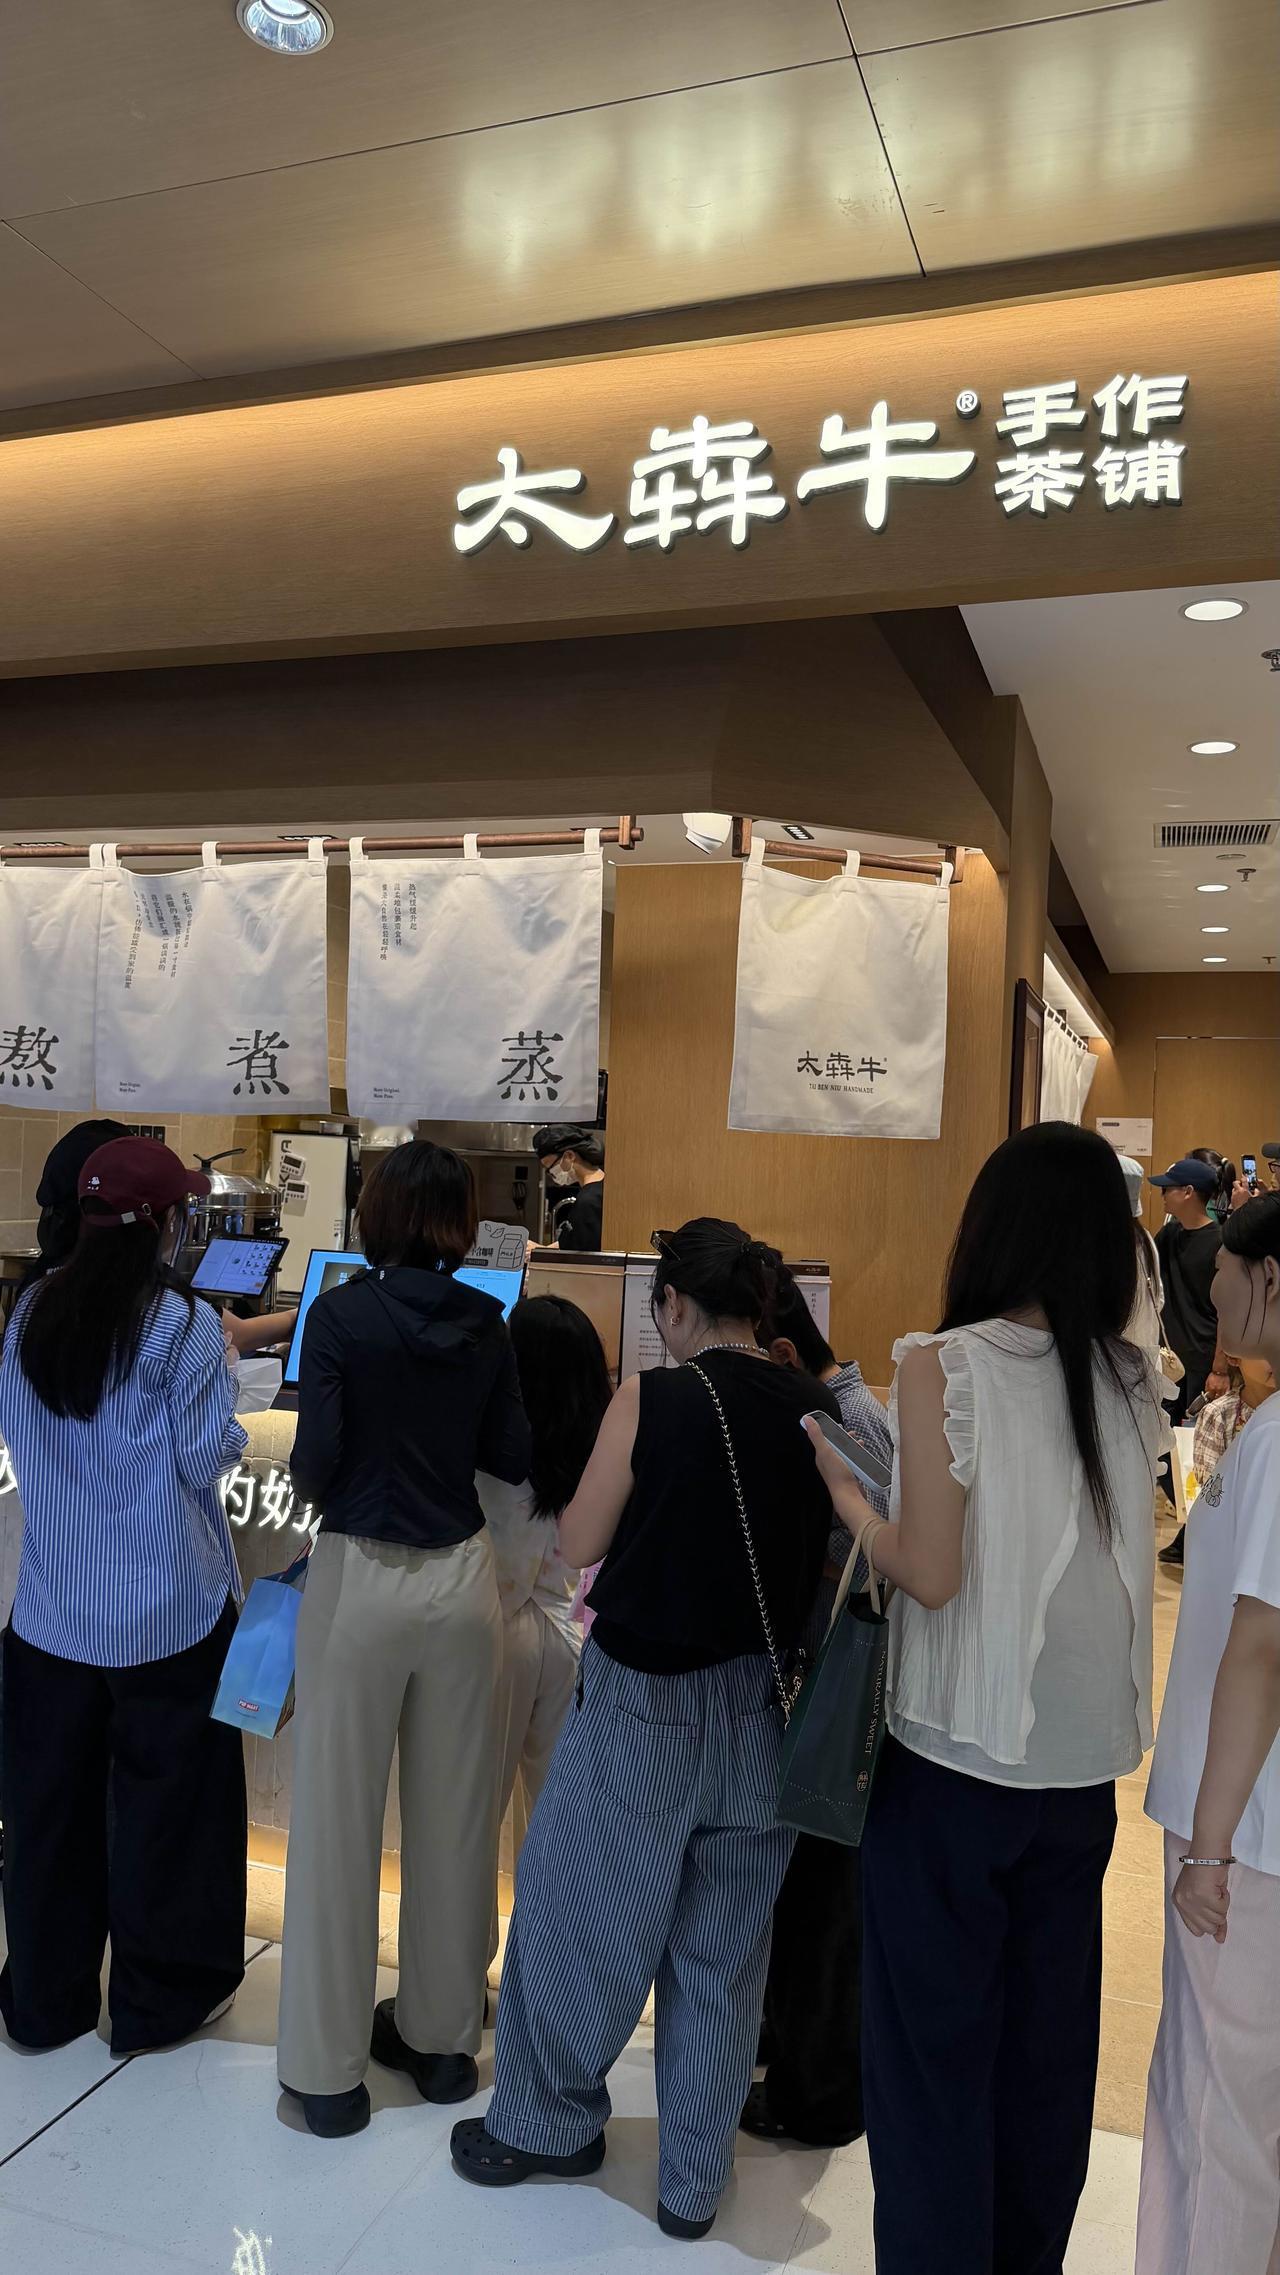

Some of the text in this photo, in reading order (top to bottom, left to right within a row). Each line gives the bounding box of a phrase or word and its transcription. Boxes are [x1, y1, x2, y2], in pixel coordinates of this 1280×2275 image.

[995, 373, 1188, 447] 手作
[453, 400, 977, 553] 太犇牛
[994, 440, 1187, 514] 茶铺
[0, 1025, 60, 1091] 熬
[228, 1029, 290, 1095] 煮
[497, 1030, 564, 1101] 蒸
[797, 1050, 888, 1082] 太犇牛
[818, 1083, 829, 1091] BEN
[843, 1085, 874, 1094] HANDMADE
[865, 1650, 887, 1755] NATURALLY SWEET
